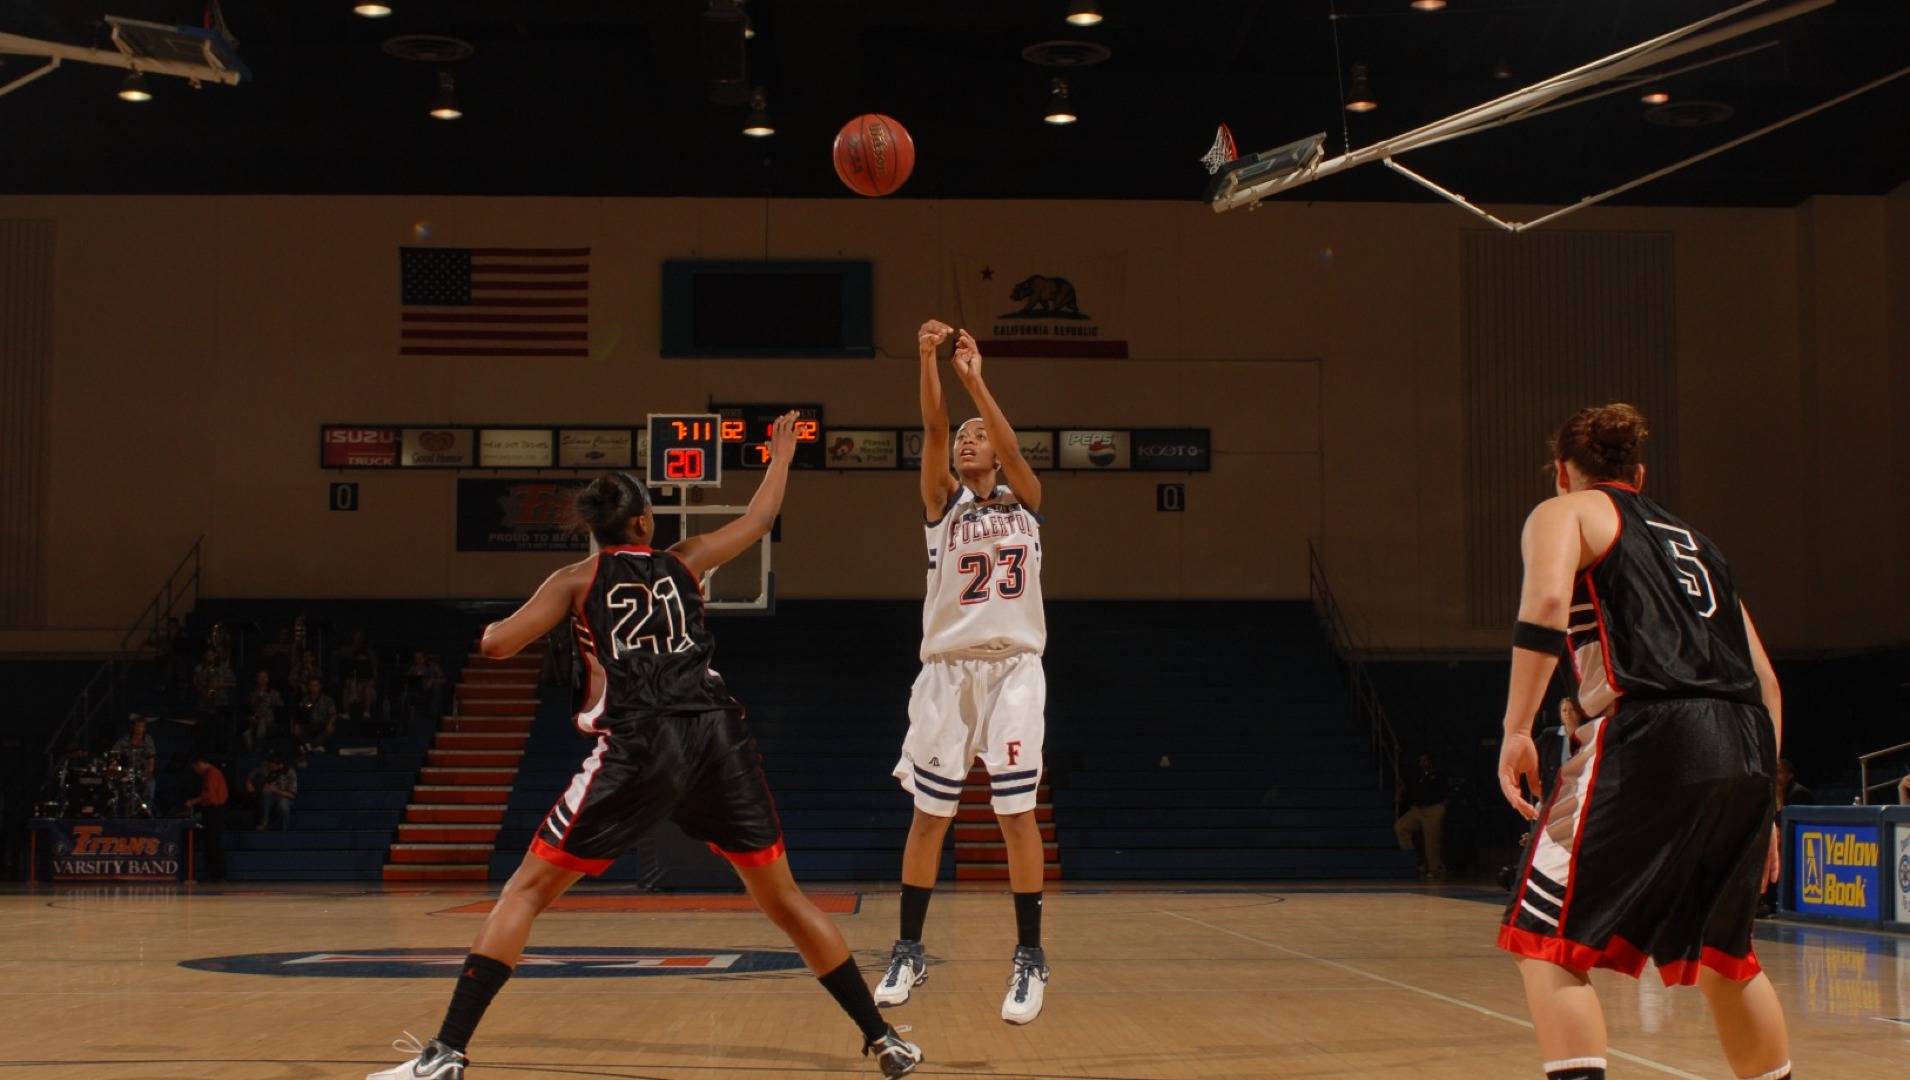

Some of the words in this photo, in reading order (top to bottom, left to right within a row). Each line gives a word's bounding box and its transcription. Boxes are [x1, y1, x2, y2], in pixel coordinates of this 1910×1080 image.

[993, 324, 1049, 337] CALIFORNIA
[1053, 325, 1099, 338] REPUBLIC
[324, 429, 395, 443] ISUZU
[671, 420, 713, 442] 7:11
[721, 420, 746, 440] 62
[1068, 433, 1117, 446] PEPSI
[347, 456, 393, 466] TRUCK
[667, 449, 702, 478] 20
[488, 532, 531, 543] PROUD
[532, 532, 550, 543] TO
[958, 544, 1028, 606] 23
[1645, 519, 1719, 619] 5
[606, 575, 695, 660] 21
[1005, 740, 1022, 766] F
[1824, 832, 1880, 867] Yellow
[53, 860, 125, 874] VARSITY
[128, 860, 179, 874] BAND
[1823, 873, 1867, 908] Book
